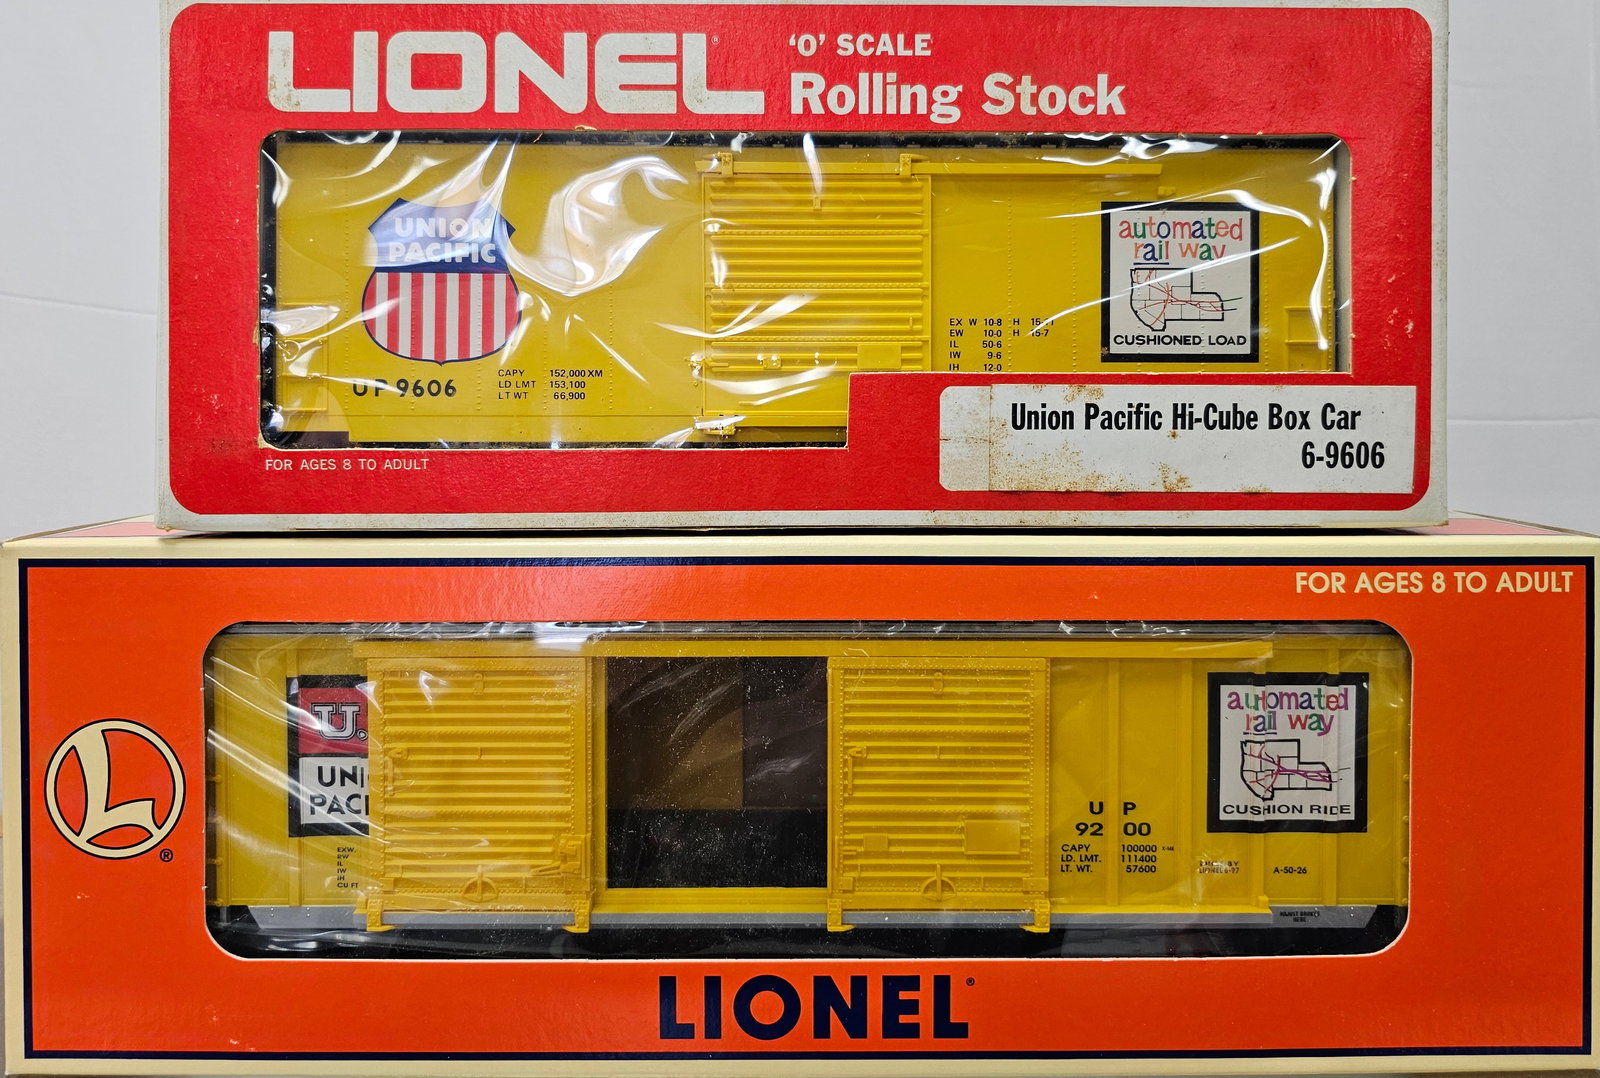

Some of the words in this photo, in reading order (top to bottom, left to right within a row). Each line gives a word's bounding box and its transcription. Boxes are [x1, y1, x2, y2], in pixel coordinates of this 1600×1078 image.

[836, 33, 932, 56] SCALE
[267, 31, 765, 114] LIONEL
[790, 72, 963, 124] Rolling
[981, 72, 1126, 116] Stock
[394, 217, 493, 239] UNION
[1118, 216, 1243, 241] automated
[388, 242, 497, 264] PACIFIC
[1133, 240, 1170, 262] rail
[949, 318, 963, 326] EX
[968, 318, 978, 326] W
[1012, 318, 1021, 326] H
[949, 329, 964, 337] EW
[1113, 334, 1203, 346] CUSHIONED
[1208, 335, 1247, 346] LOAD
[949, 340, 959, 348] IL
[949, 351, 961, 359] IW
[497, 369, 525, 377] CAPY
[549, 369, 586, 379] 152,000
[587, 369, 604, 377] XM
[949, 363, 960, 371] IH
[396, 378, 457, 398] 9606
[498, 381, 512, 389] LD
[515, 380, 536, 389] LMT
[549, 380, 586, 390] 153,100
[498, 392, 510, 400] LT
[513, 392, 528, 400] WT
[553, 392, 586, 401] 66,900
[1011, 402, 1075, 430] Union
[1084, 402, 1163, 430] Pacific
[1172, 402, 1258, 430] Hi-Cube
[1268, 402, 1311, 430] Box
[1321, 402, 1361, 430] Car
[1301, 440, 1385, 469] 6-9606
[265, 459, 293, 470] FOR
[300, 459, 337, 470] AGES
[343, 458, 352, 470] 8
[358, 459, 377, 470] TO
[384, 458, 429, 470] ADULT
[1295, 572, 1346, 593] FOR
[1353, 572, 1424, 593] AGES
[1431, 572, 1446, 593] 8
[1453, 571, 1487, 593] TO
[1495, 571, 1574, 593] ADULT
[1227, 688, 1348, 711] automated
[1246, 711, 1277, 732] rail
[1288, 713, 1334, 736] way
[1089, 801, 1104, 815] U
[1123, 802, 1137, 815] P
[1223, 804, 1303, 815] CUSHION
[1309, 804, 1351, 815] RIDE
[1061, 844, 1090, 852] CAPY
[1121, 844, 1157, 852] 100000
[1126, 865, 1157, 873] 57600
[1273, 866, 1307, 874] A-50-26
[659, 975, 969, 1040] LIONEL
